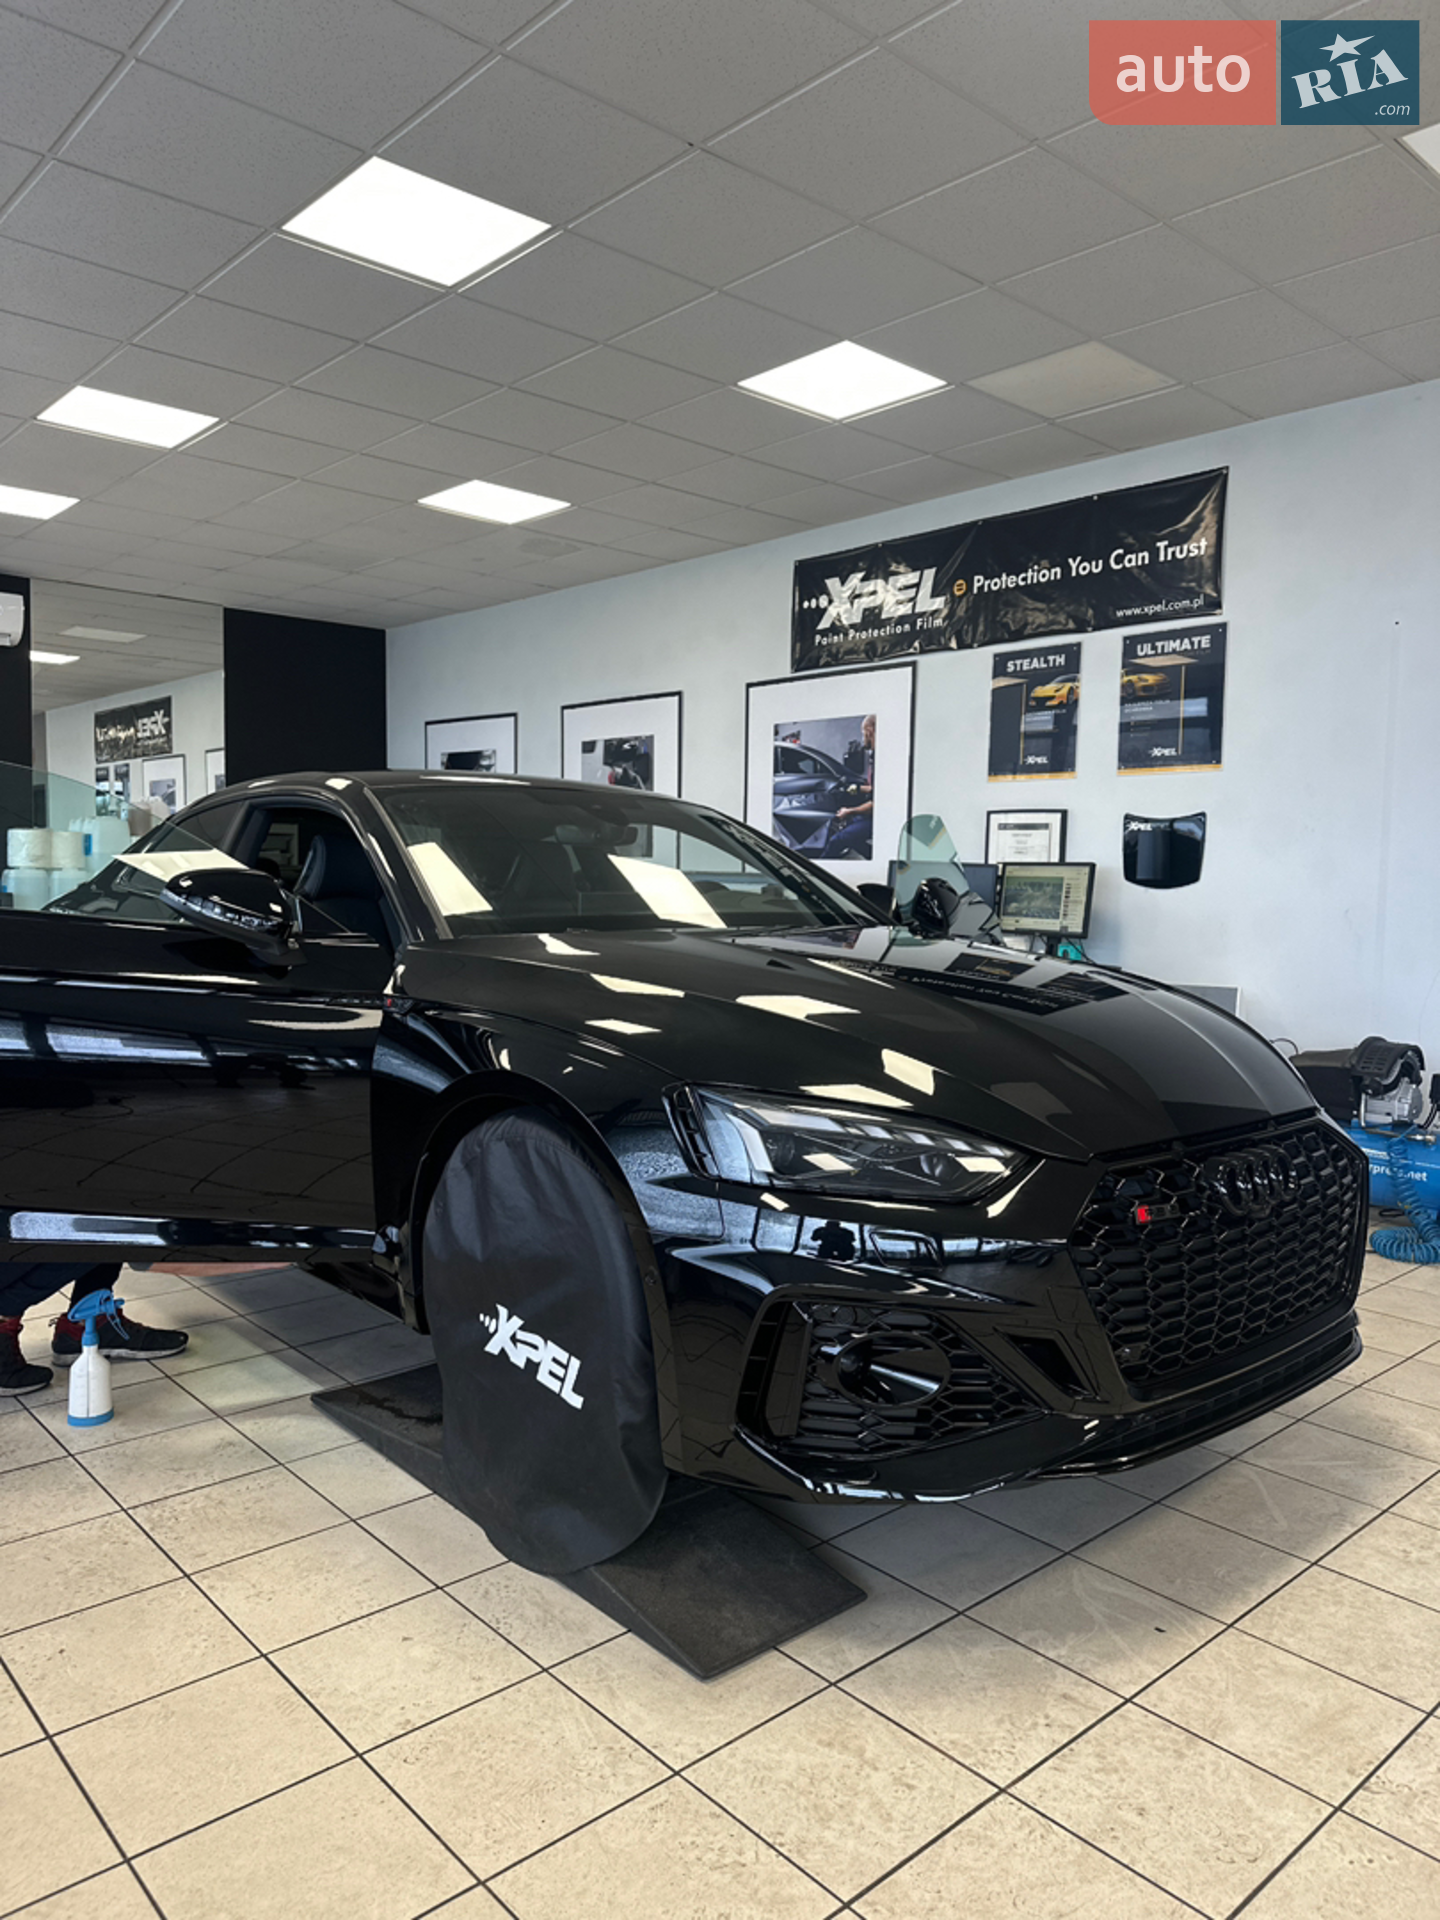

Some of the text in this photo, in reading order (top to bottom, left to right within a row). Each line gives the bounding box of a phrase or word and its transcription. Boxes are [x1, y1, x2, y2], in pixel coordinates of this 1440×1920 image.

[816, 537, 1208, 630] XPEL Protection You Can Trust
[1116, 594, 1204, 618] www.xpel.com.pl
[815, 617, 943, 646] Paint Protection Film
[1137, 635, 1211, 656] ULTIMATE
[1006, 654, 1065, 672] STEALTH
[484, 1303, 584, 1410] XPEL
